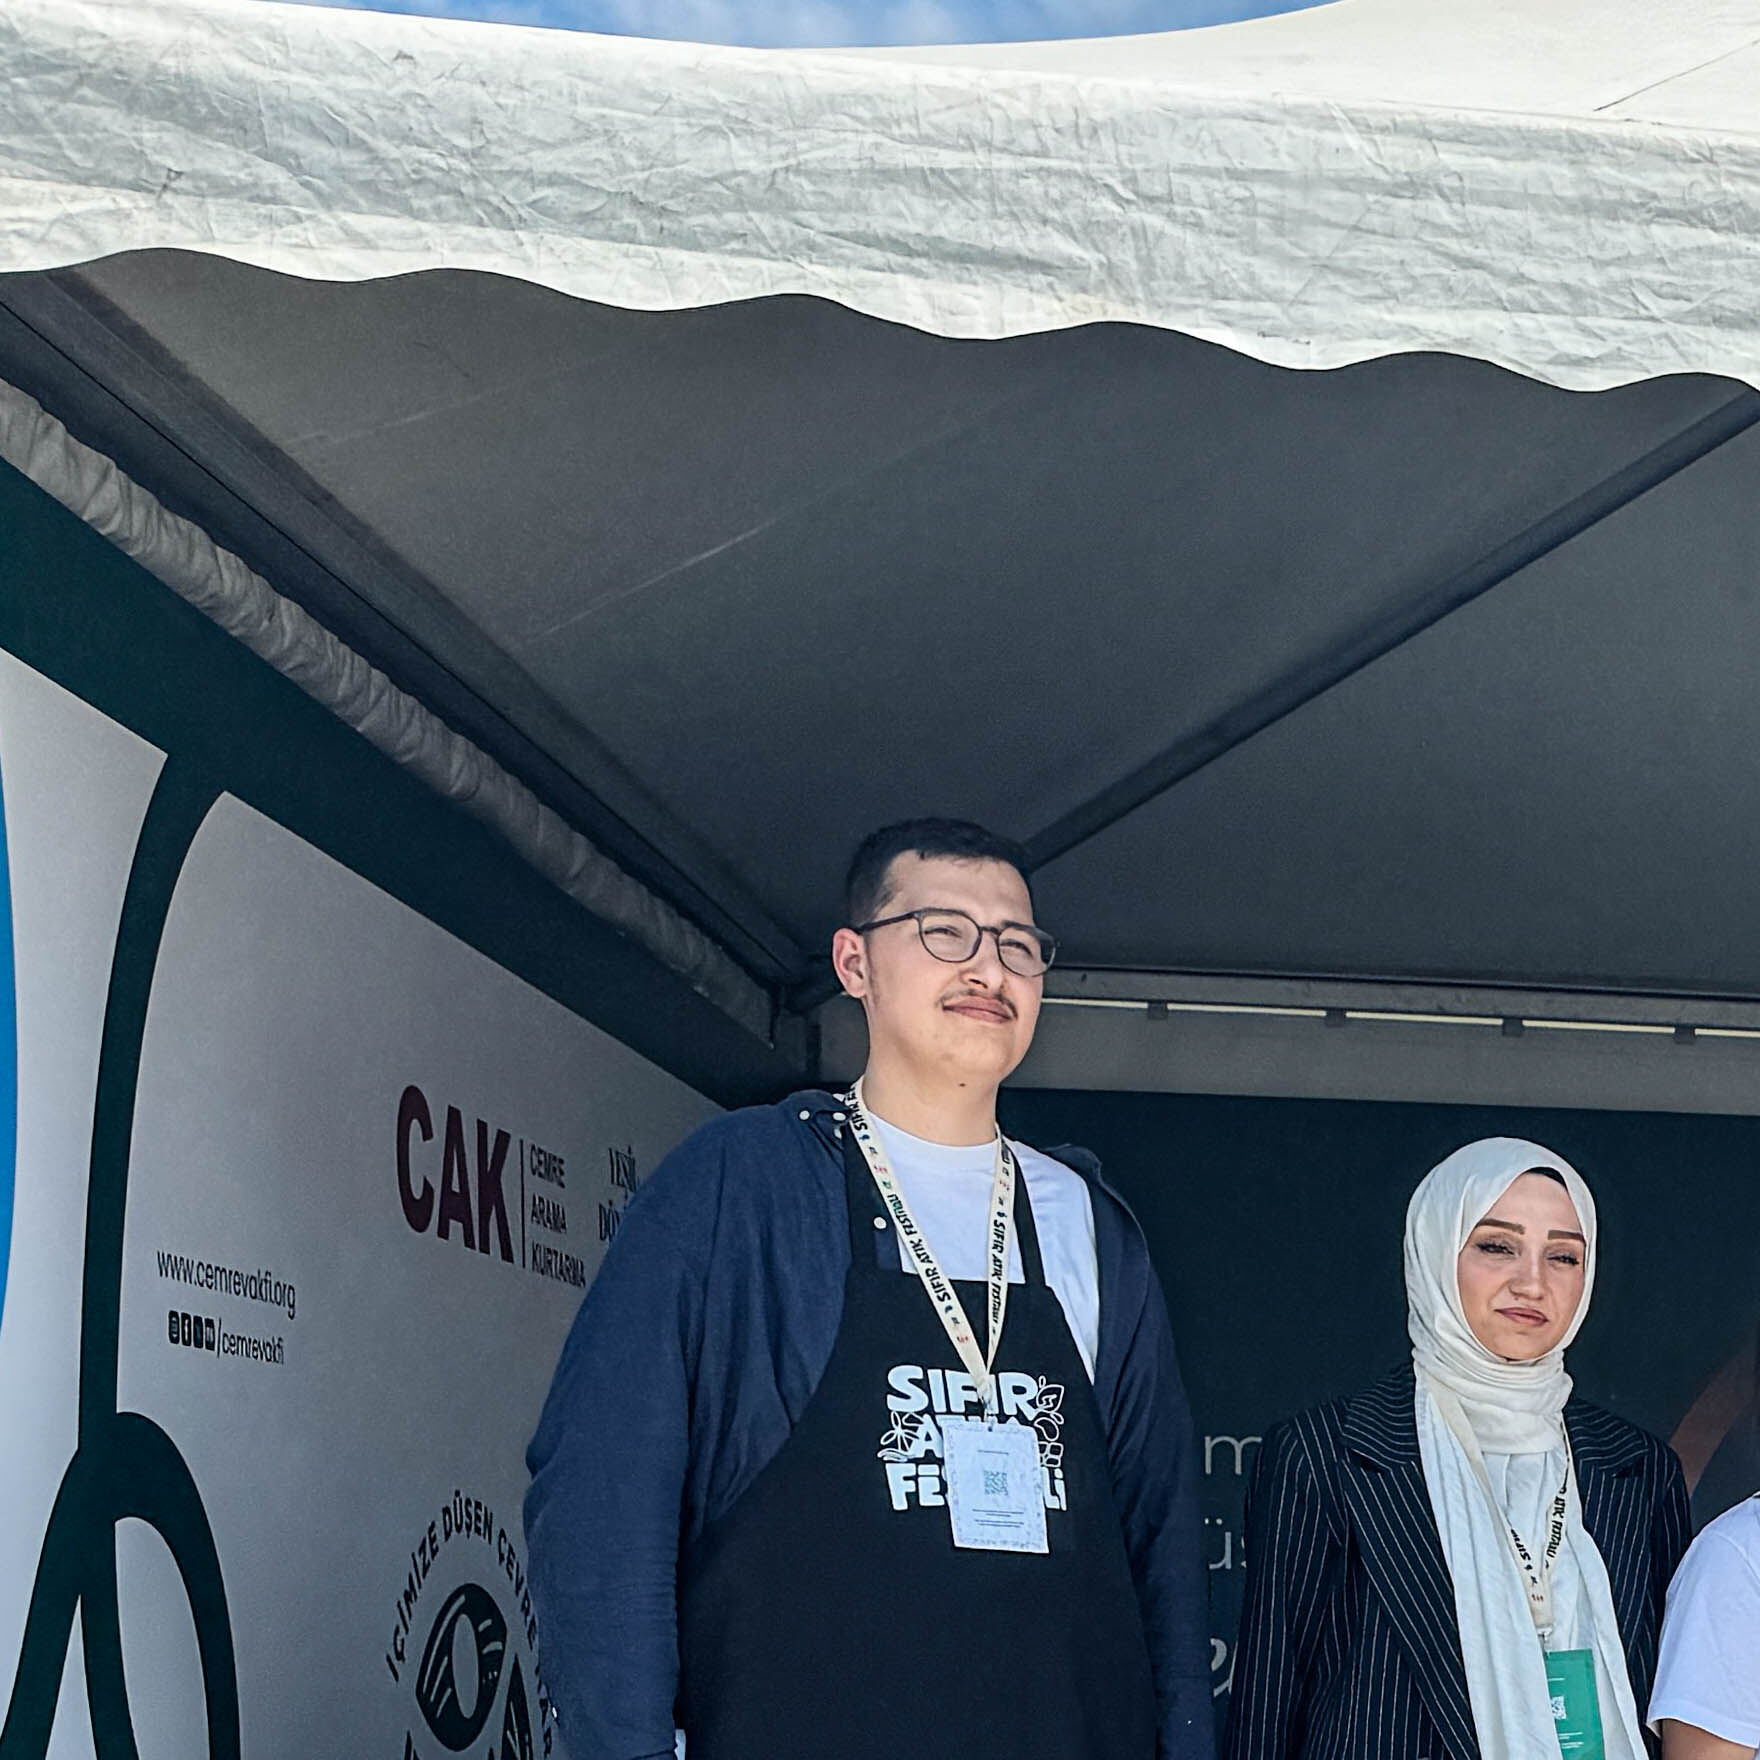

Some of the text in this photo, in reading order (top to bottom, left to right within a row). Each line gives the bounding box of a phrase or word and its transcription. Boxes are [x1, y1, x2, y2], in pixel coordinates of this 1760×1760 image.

[396, 1084, 515, 1265] CAK
[530, 1193, 567, 1234] ARAMA
[157, 1250, 296, 1320] www.cemrevakfi.org
[886, 1364, 1039, 1421] SIFIR
